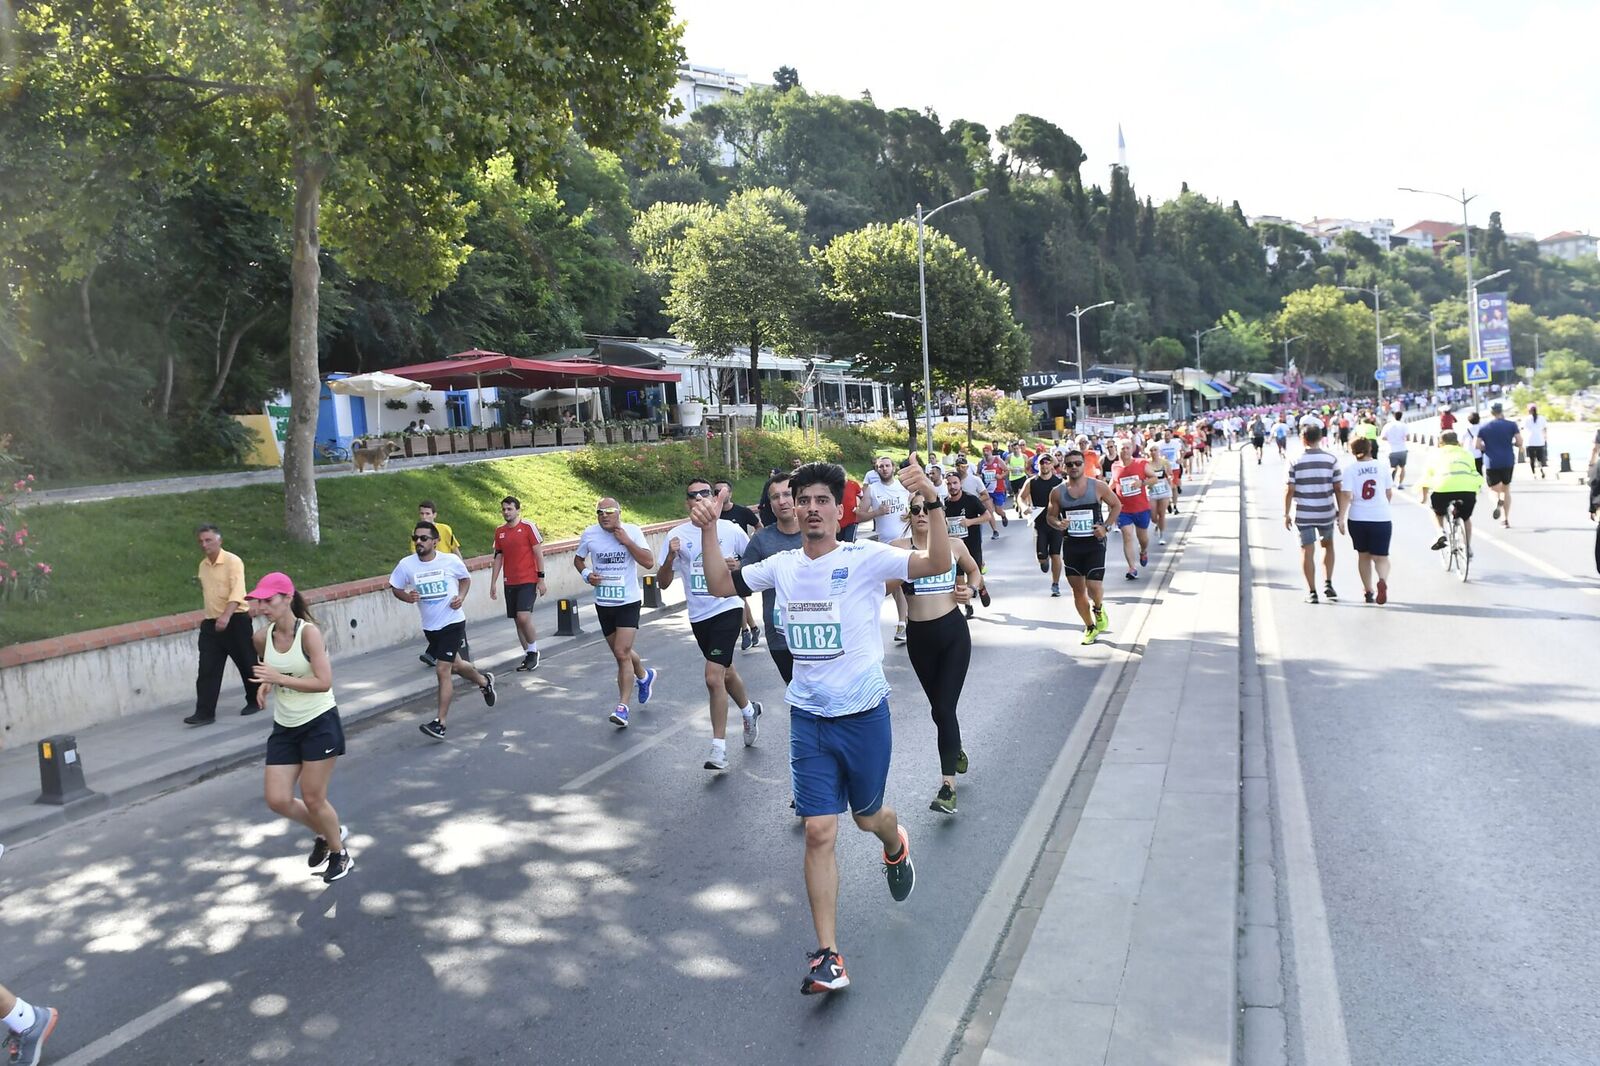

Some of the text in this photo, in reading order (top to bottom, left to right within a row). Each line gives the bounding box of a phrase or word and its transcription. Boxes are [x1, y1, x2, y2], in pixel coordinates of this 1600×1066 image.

[1358, 467, 1377, 476] JAMES
[1362, 479, 1377, 500] 6
[596, 551, 626, 559] SPARTAN
[419, 581, 445, 595] 1183
[599, 586, 623, 598] 1015
[792, 625, 838, 649] 0182
